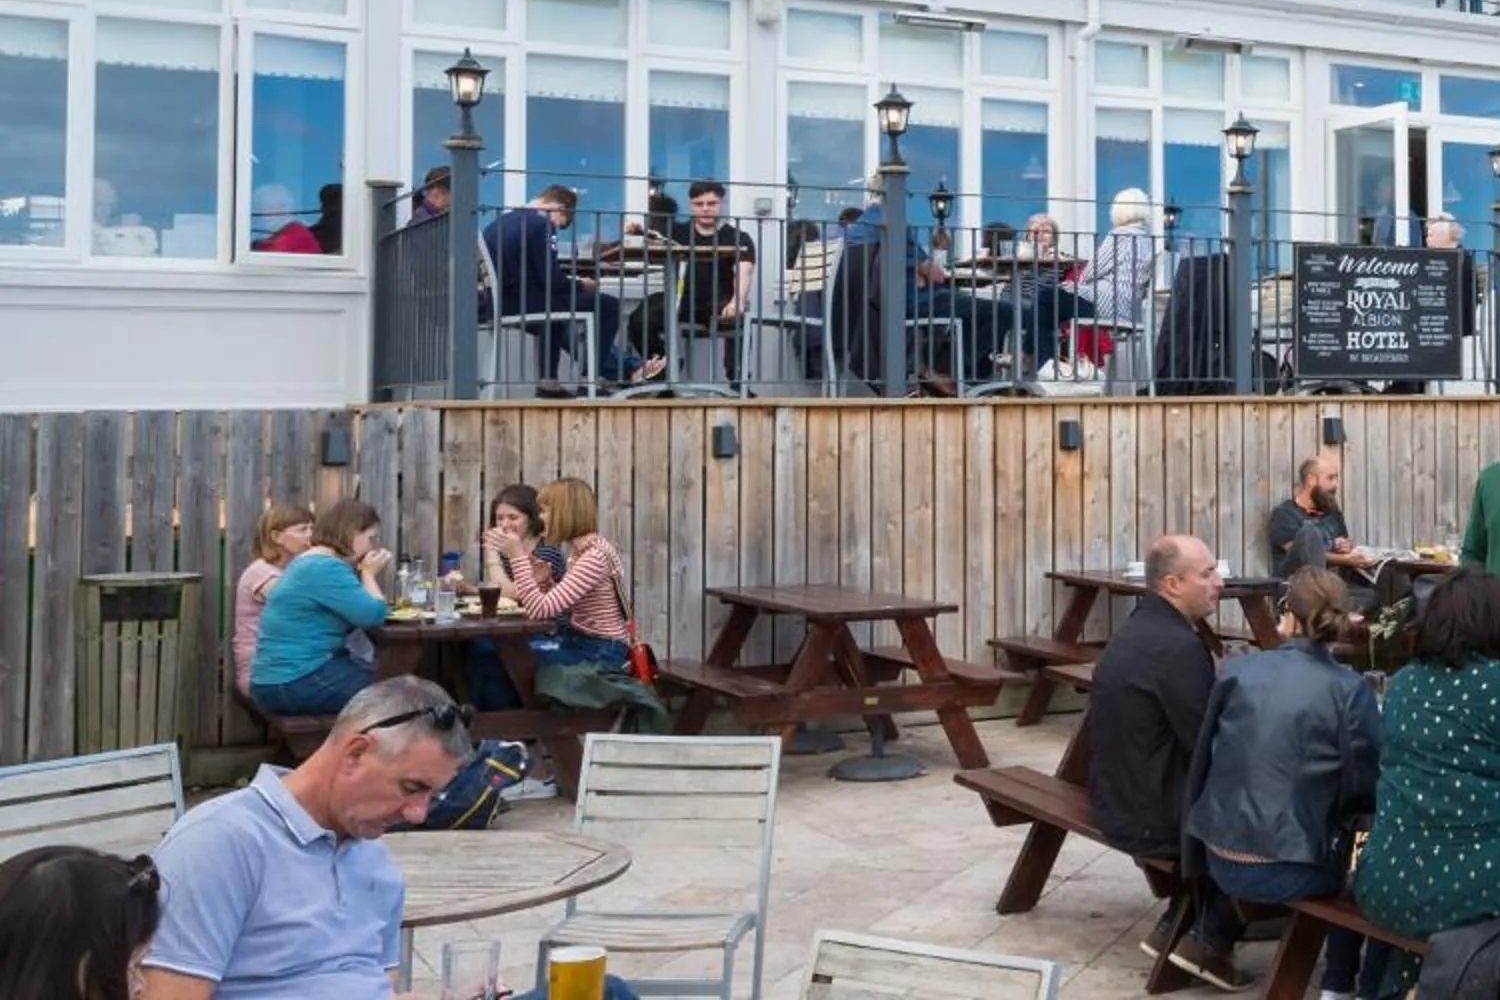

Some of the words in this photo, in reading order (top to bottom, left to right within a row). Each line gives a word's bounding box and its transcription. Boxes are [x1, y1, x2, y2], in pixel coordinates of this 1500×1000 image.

[1337, 254, 1420, 276] Welcome
[1346, 290, 1411, 312] ROYAL
[1351, 313, 1403, 327] ALBION
[1346, 331, 1409, 350] HOTEL
